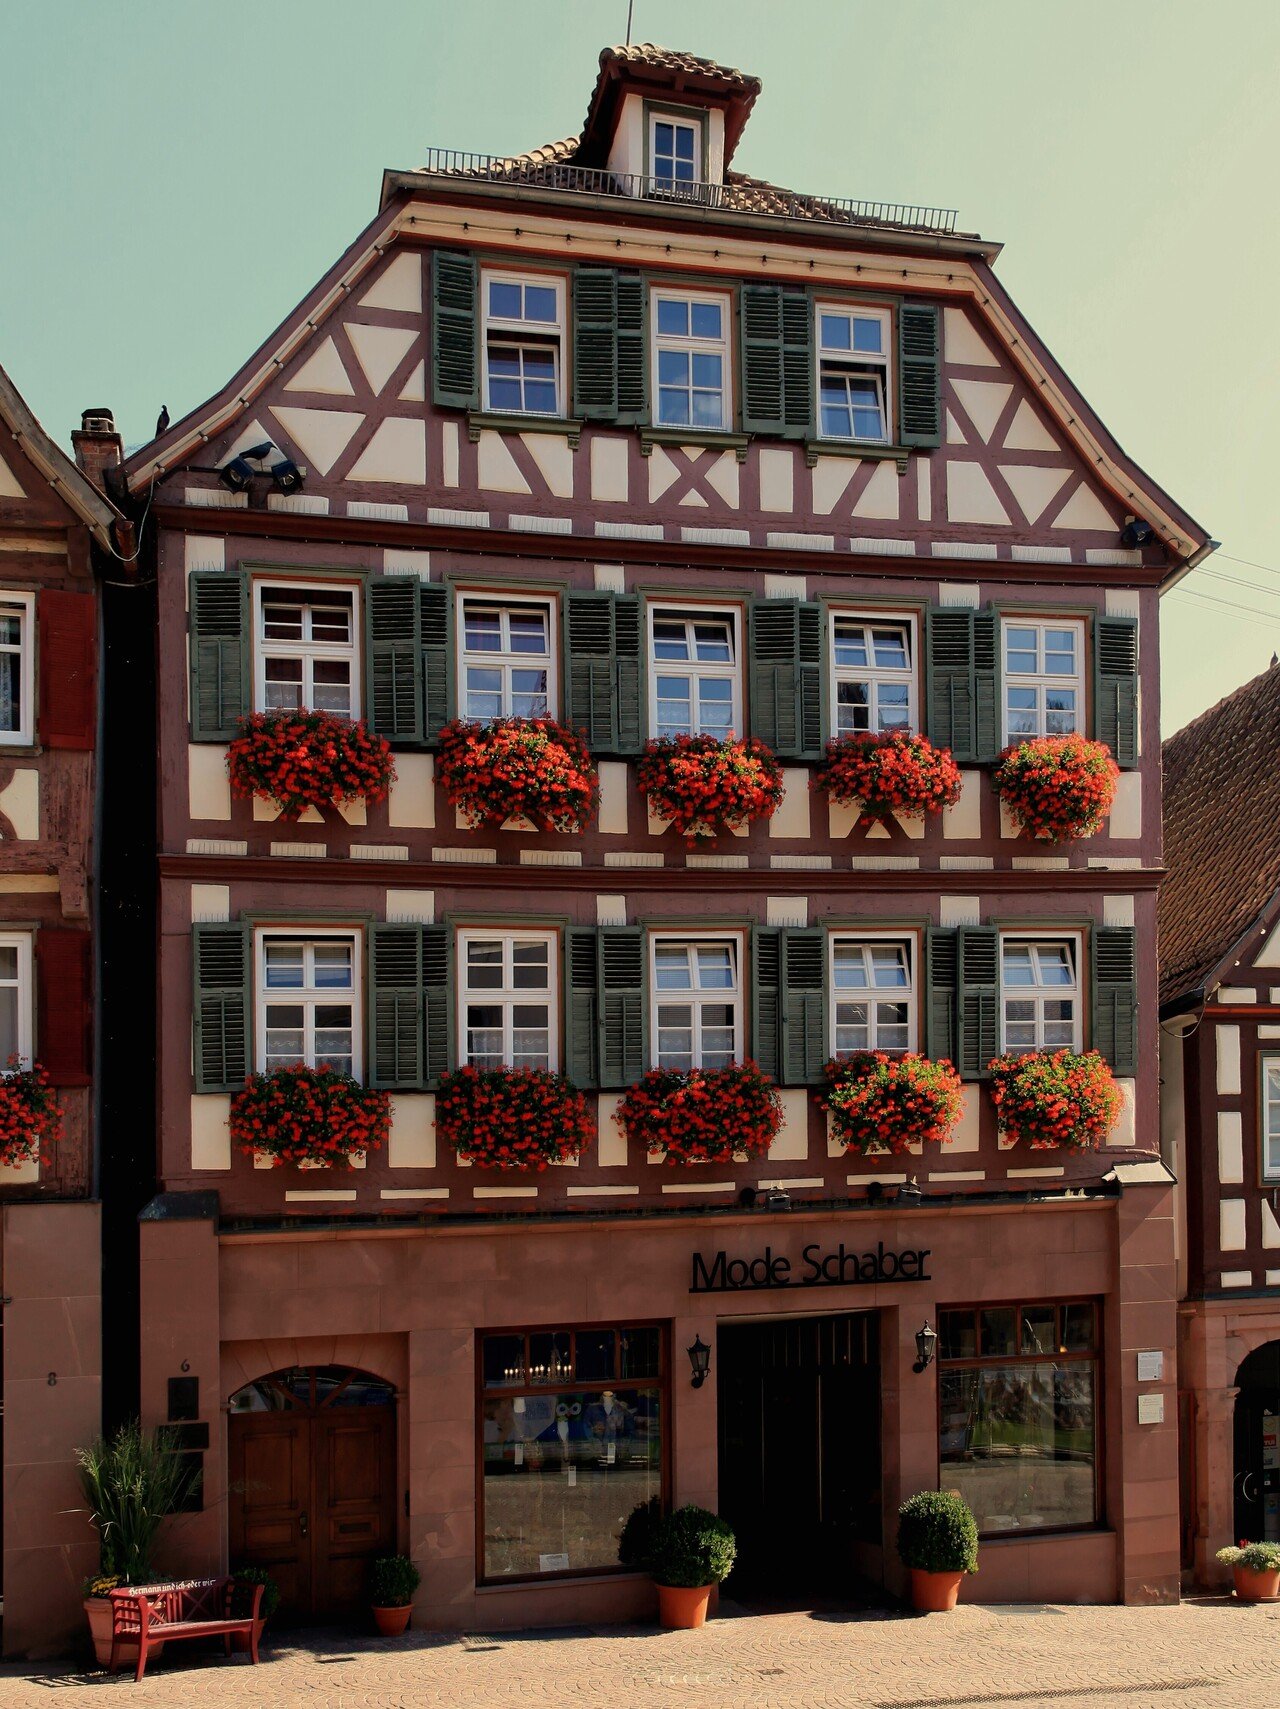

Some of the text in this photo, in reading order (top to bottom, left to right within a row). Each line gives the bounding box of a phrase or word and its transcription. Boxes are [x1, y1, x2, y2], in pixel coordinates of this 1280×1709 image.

[693, 1241, 931, 1290] Mode Schaber
[180, 1359, 190, 1372] 6
[47, 1372, 57, 1386] 8
